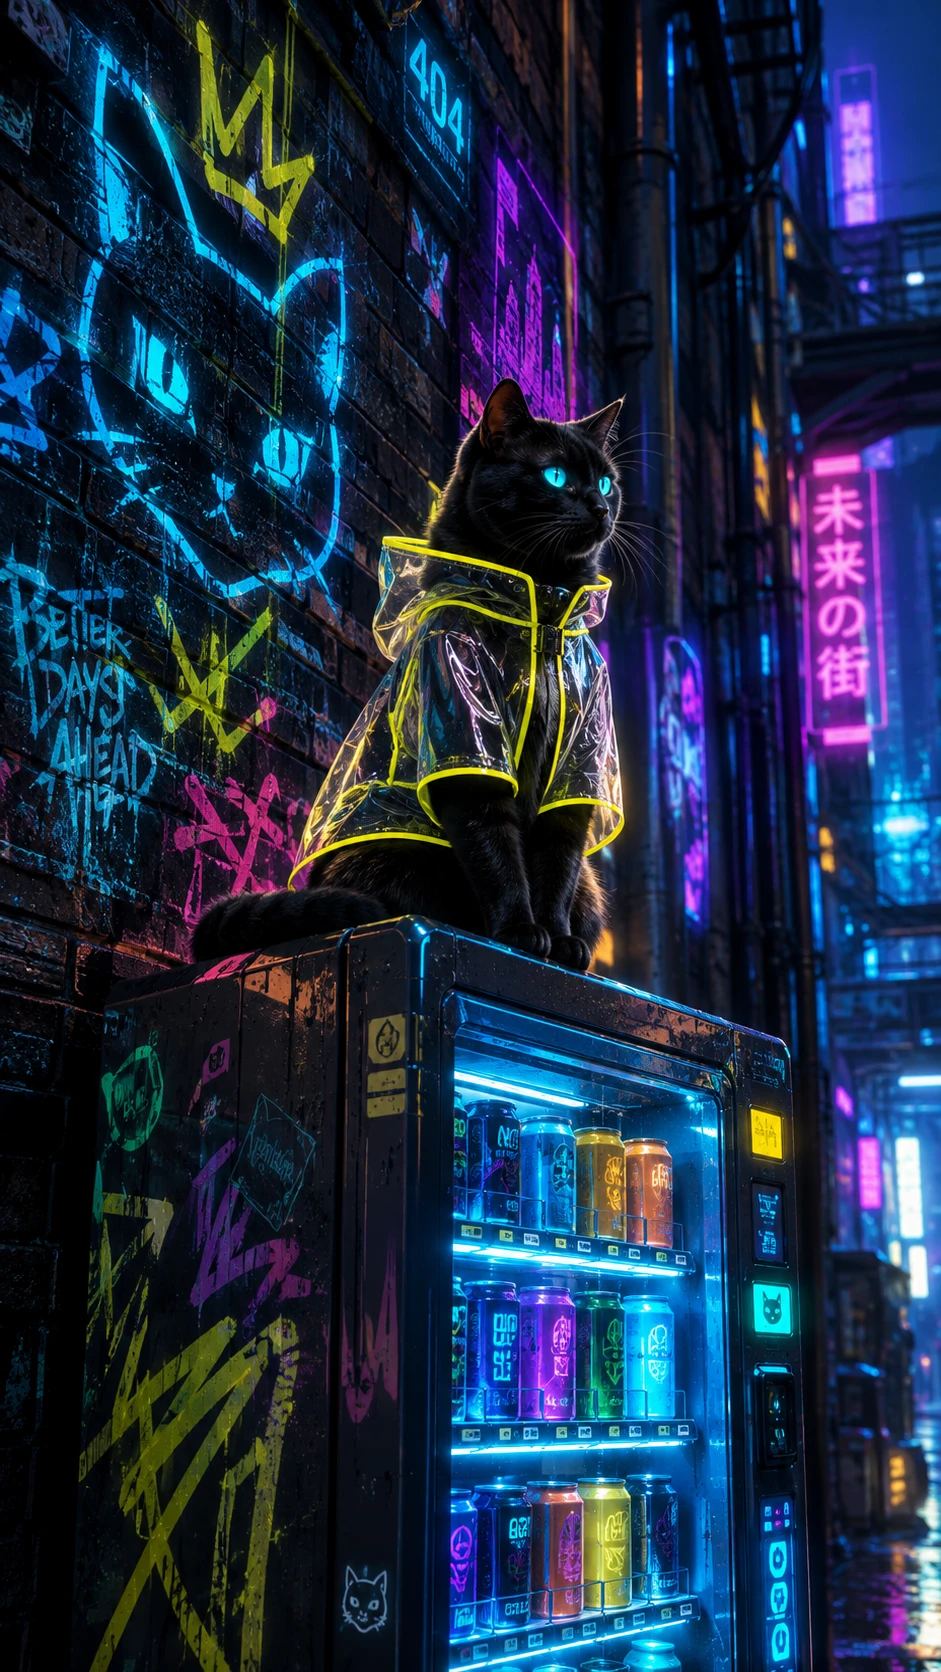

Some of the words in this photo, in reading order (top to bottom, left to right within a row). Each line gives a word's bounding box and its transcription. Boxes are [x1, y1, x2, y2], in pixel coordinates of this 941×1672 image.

[410, 39, 464, 154] 404
[3, 562, 132, 668] BETTER
[813, 484, 870, 700] 未来の街
[38, 656, 125, 730] DAYS
[48, 718, 157, 808] AHEAD
